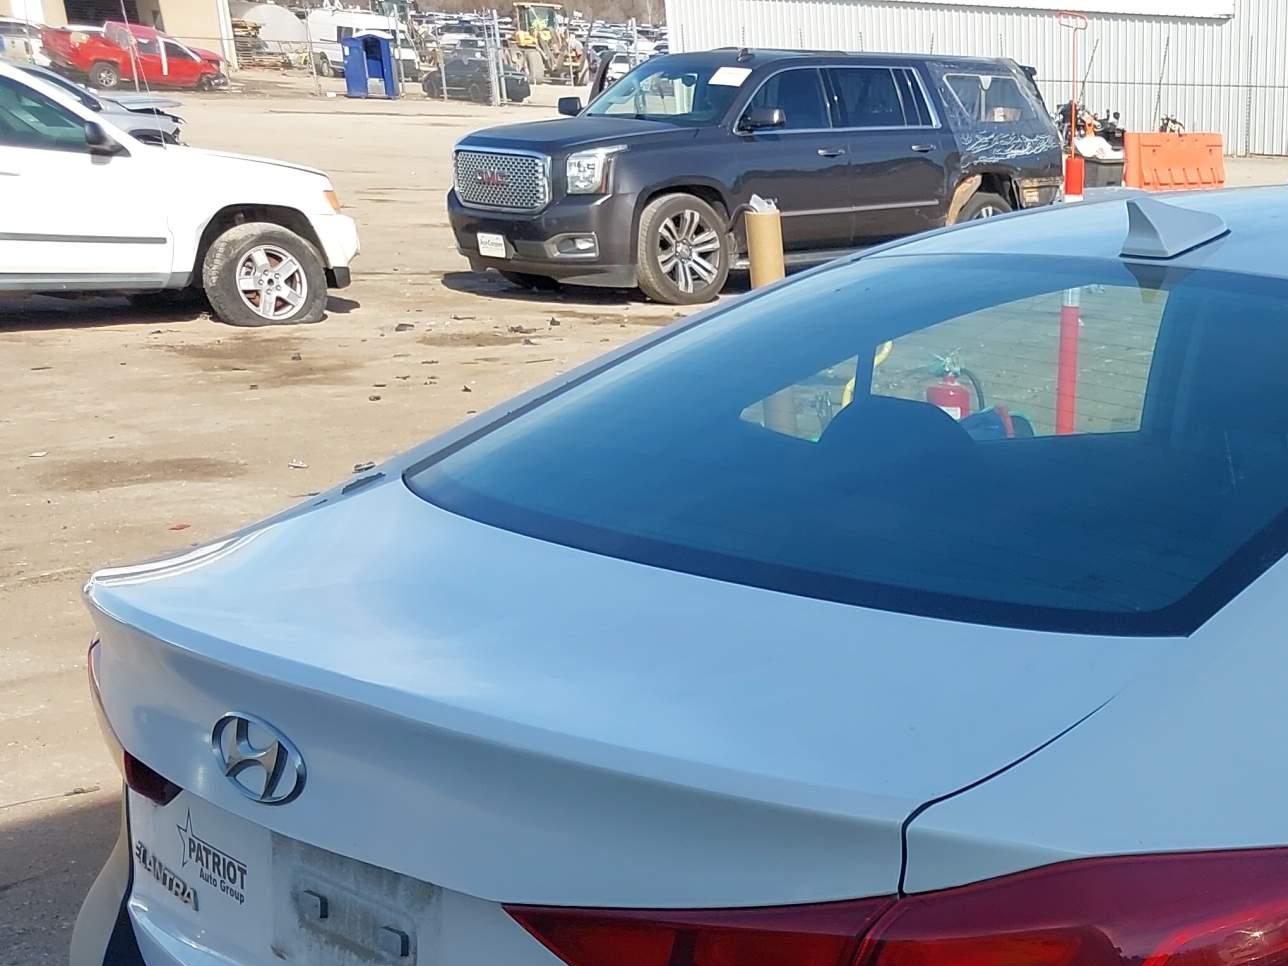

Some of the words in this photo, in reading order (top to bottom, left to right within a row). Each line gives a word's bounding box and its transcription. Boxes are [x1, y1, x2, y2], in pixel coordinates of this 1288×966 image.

[135, 840, 200, 912] ELANTRA
[188, 837, 247, 890] PATRIOT
[199, 867, 218, 888] Auto
[219, 879, 245, 905] Group
